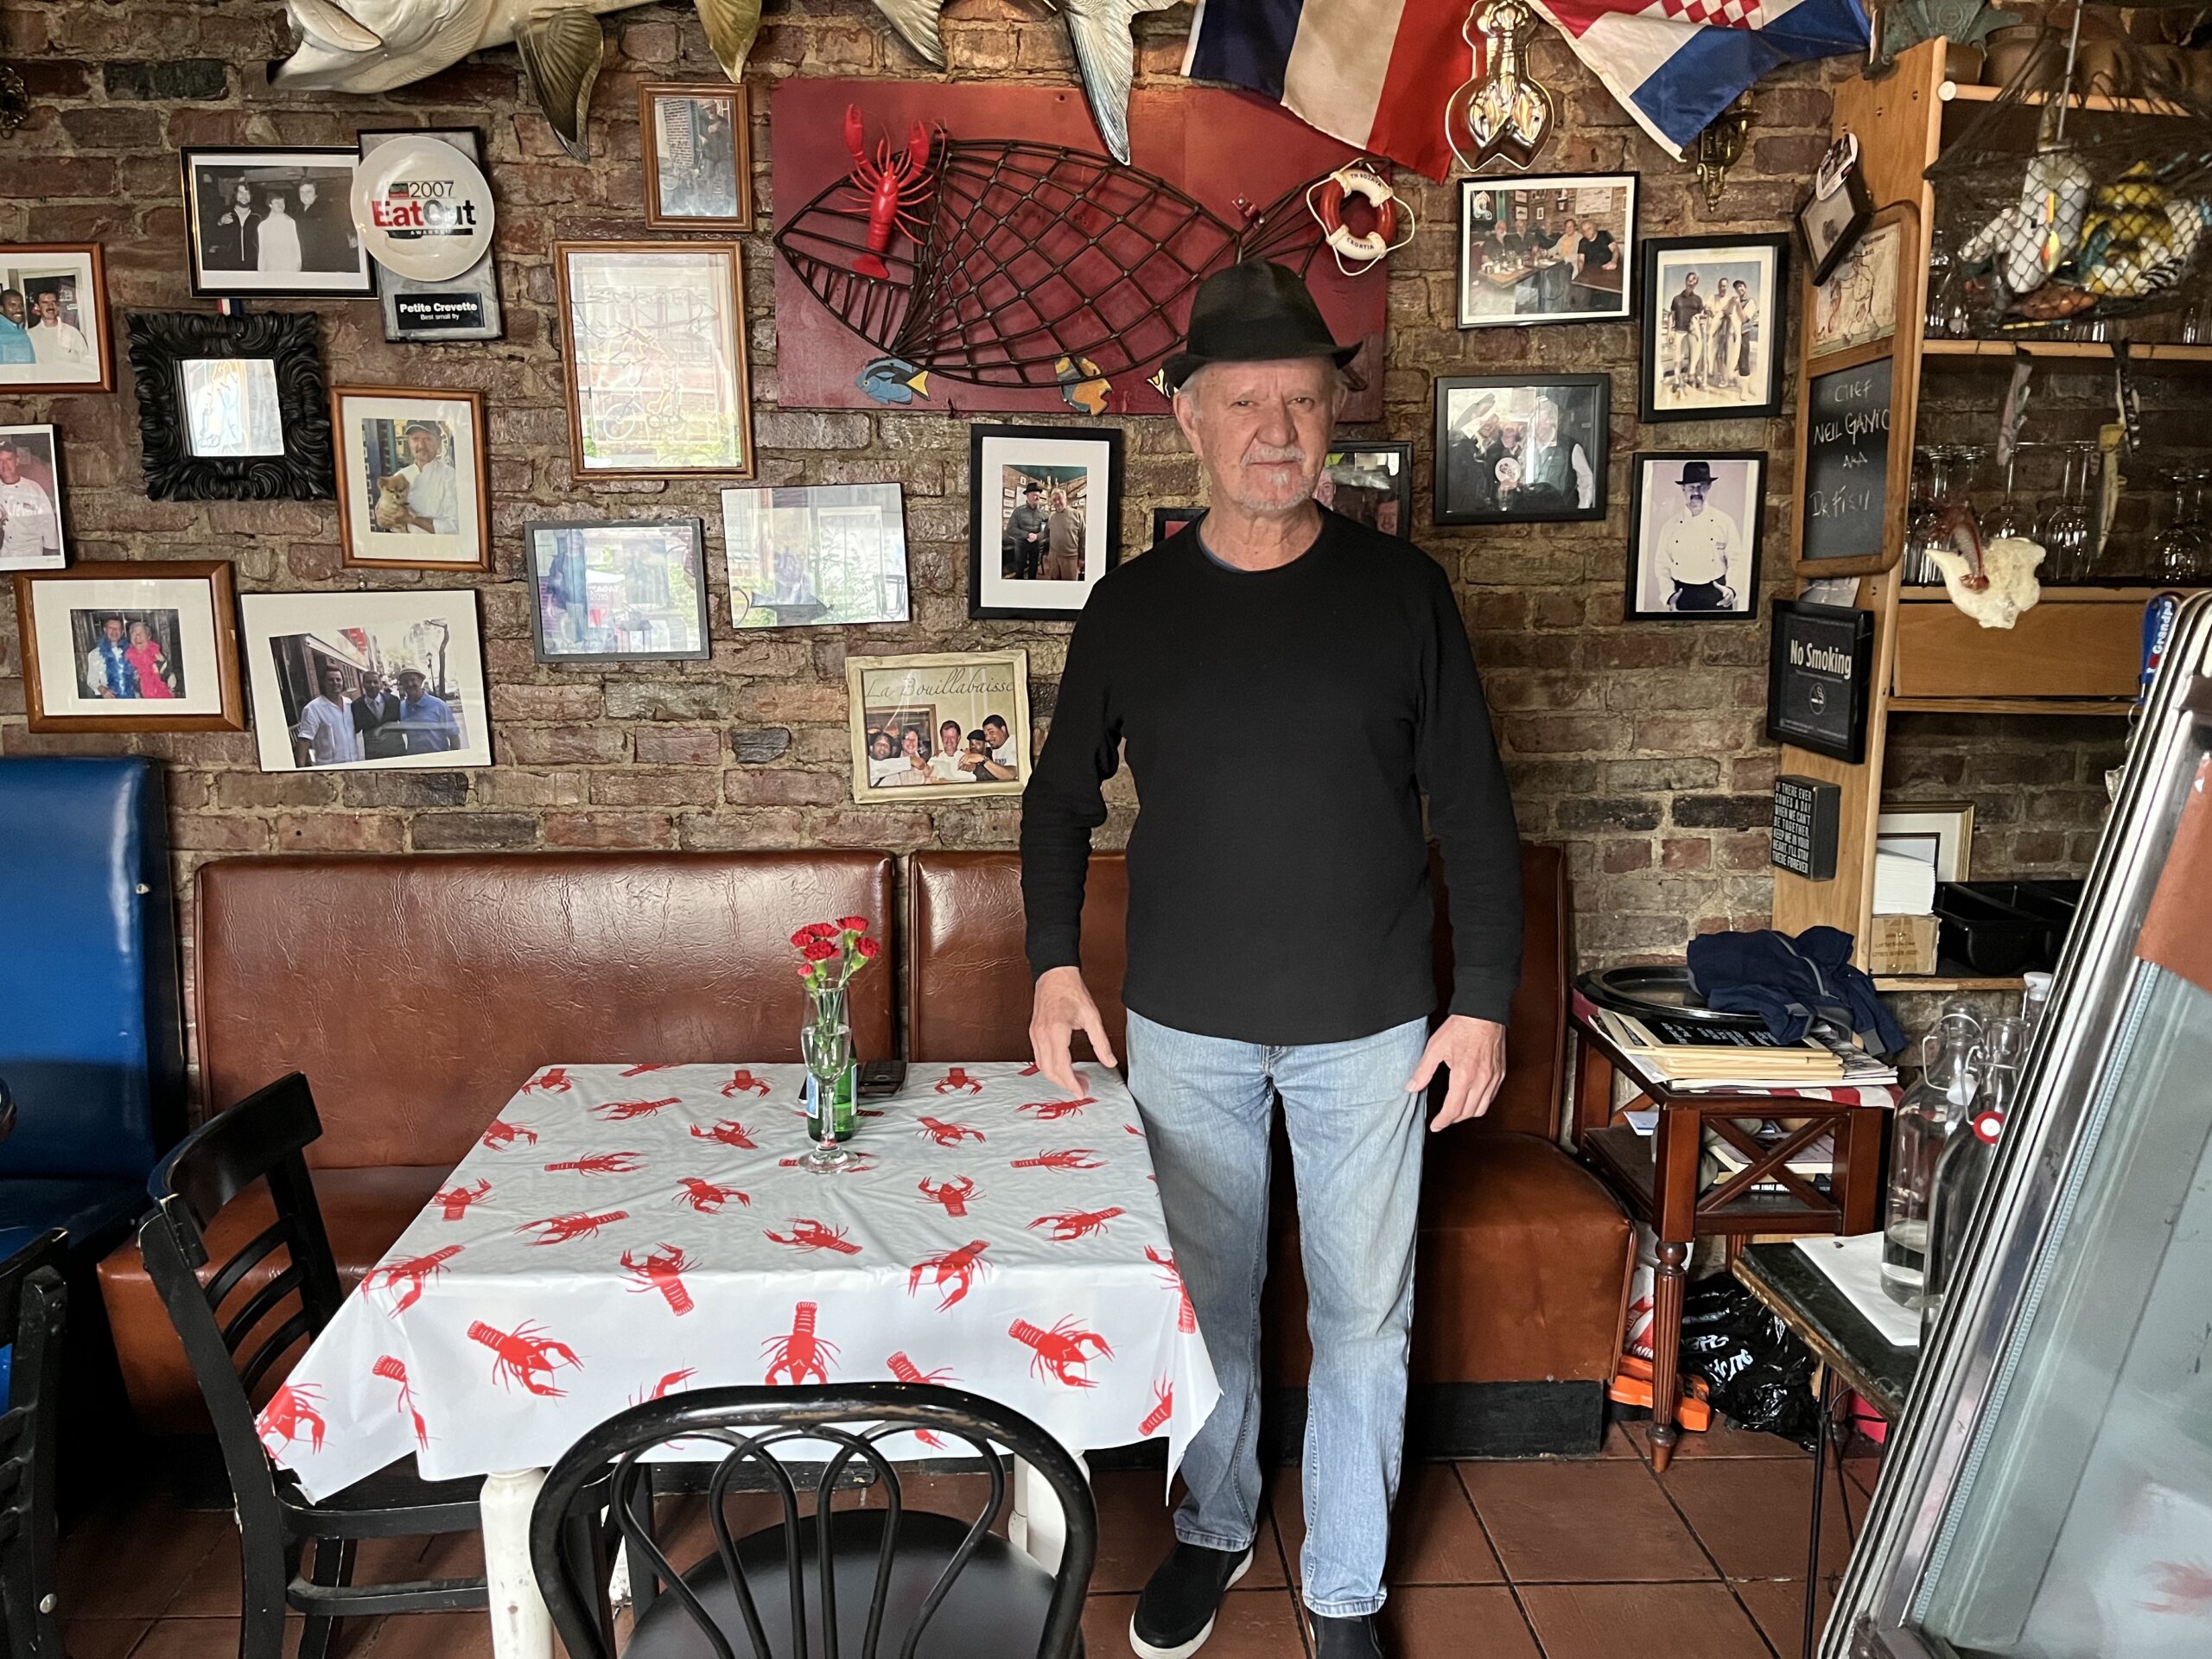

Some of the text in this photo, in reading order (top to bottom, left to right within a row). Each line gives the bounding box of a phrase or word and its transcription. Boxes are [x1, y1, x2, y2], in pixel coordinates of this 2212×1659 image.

[409, 181, 454, 198] 2007
[1346, 238, 1375, 250] CROATIA
[399, 302, 478, 313] Petite Crevette
[1814, 422, 1843, 446] NEIL
[1843, 451, 1868, 469] AKA
[2152, 601, 2173, 654] Grandpa
[1790, 639, 1804, 666] No
[1806, 642, 1853, 680] Smoking
[865, 667, 1014, 698] La Bouillabaisse
[1776, 781, 1812, 802] IF THERE EVER
[1775, 792, 1812, 814] COMES A DAY
